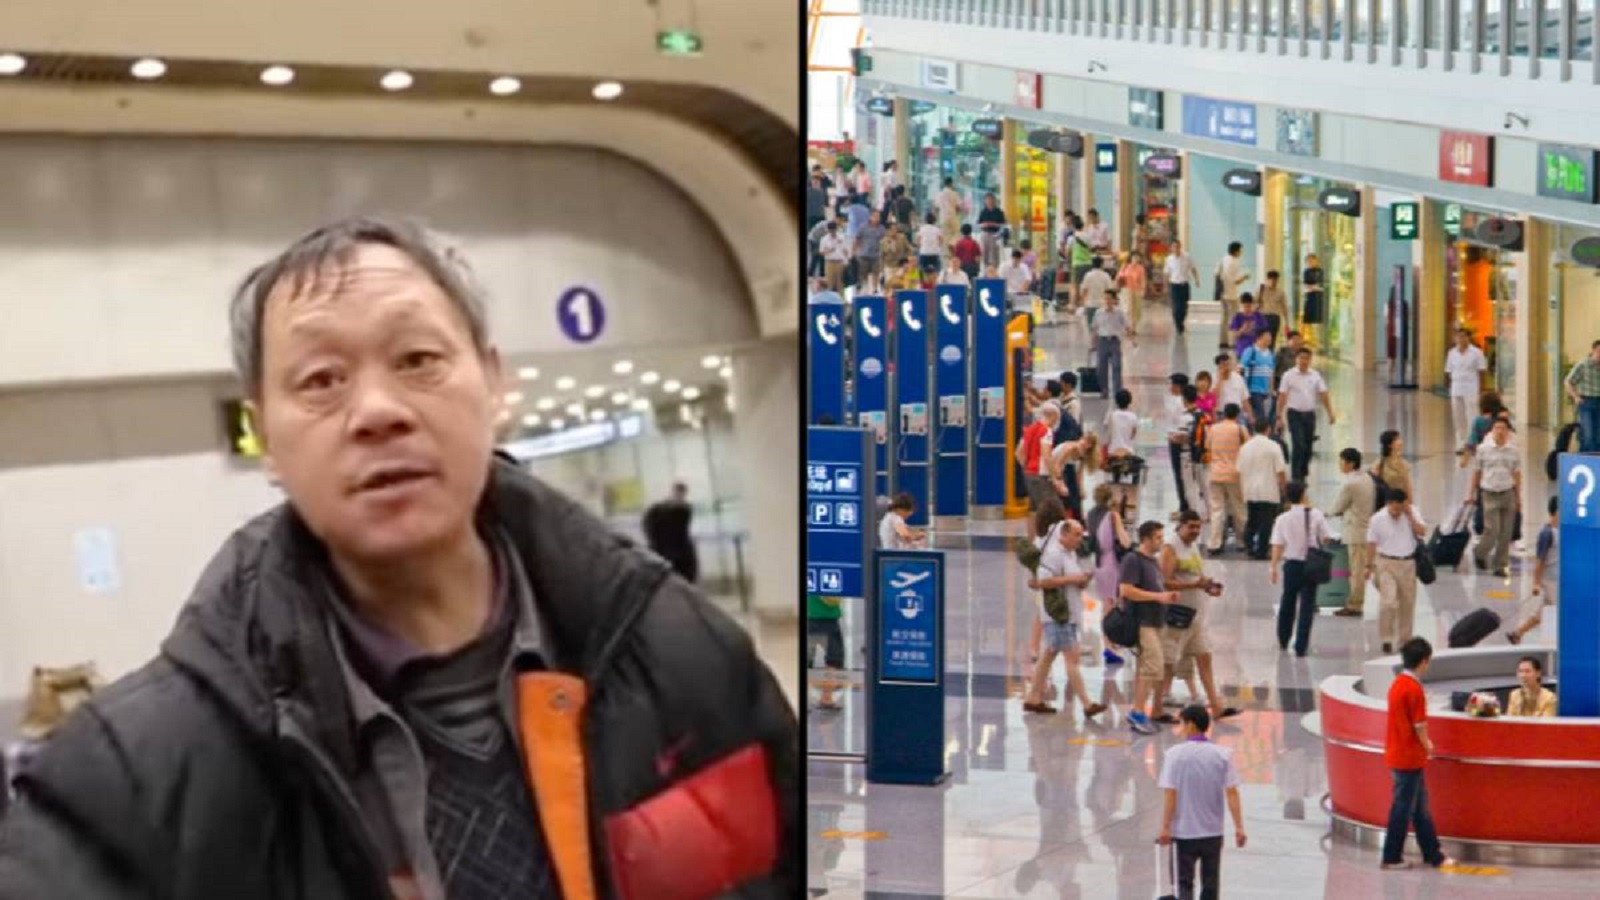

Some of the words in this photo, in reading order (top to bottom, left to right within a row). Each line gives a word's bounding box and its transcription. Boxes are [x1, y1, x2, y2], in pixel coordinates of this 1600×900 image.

[569, 294, 592, 335] 1
[1568, 464, 1595, 517] ?
[815, 503, 828, 521] P
